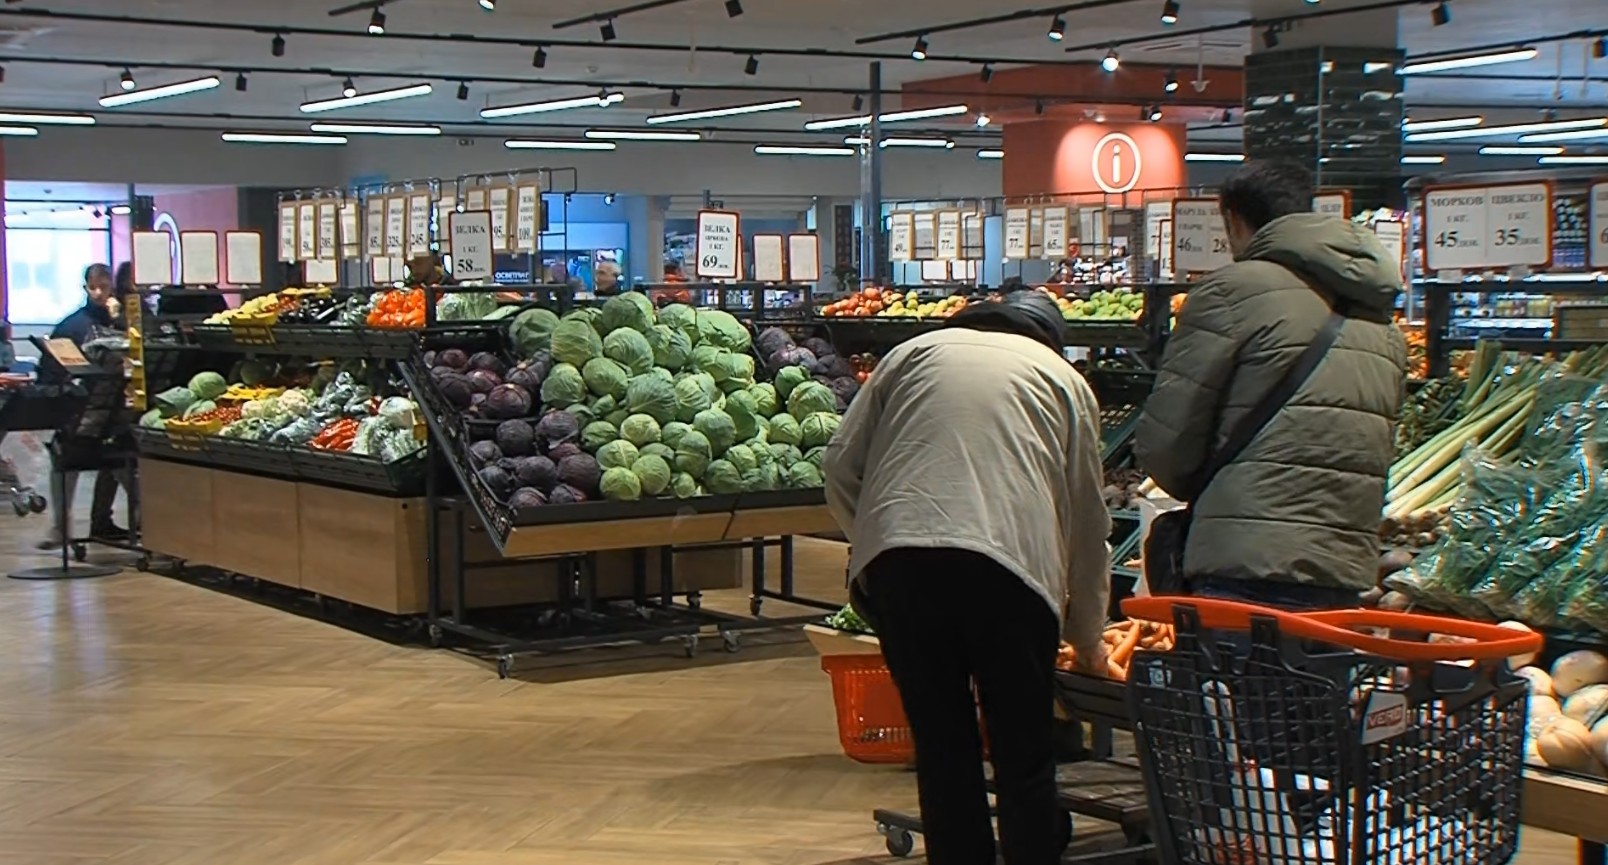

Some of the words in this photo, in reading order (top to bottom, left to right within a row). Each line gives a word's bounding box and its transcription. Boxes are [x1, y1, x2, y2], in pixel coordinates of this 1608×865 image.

[1430, 196, 1485, 207] МОРКОВ
[1177, 236, 1192, 252] 46
[1434, 230, 1459, 248] 45
[1494, 228, 1520, 246] 35
[457, 258, 474, 273] 58
[702, 254, 718, 269] 69
